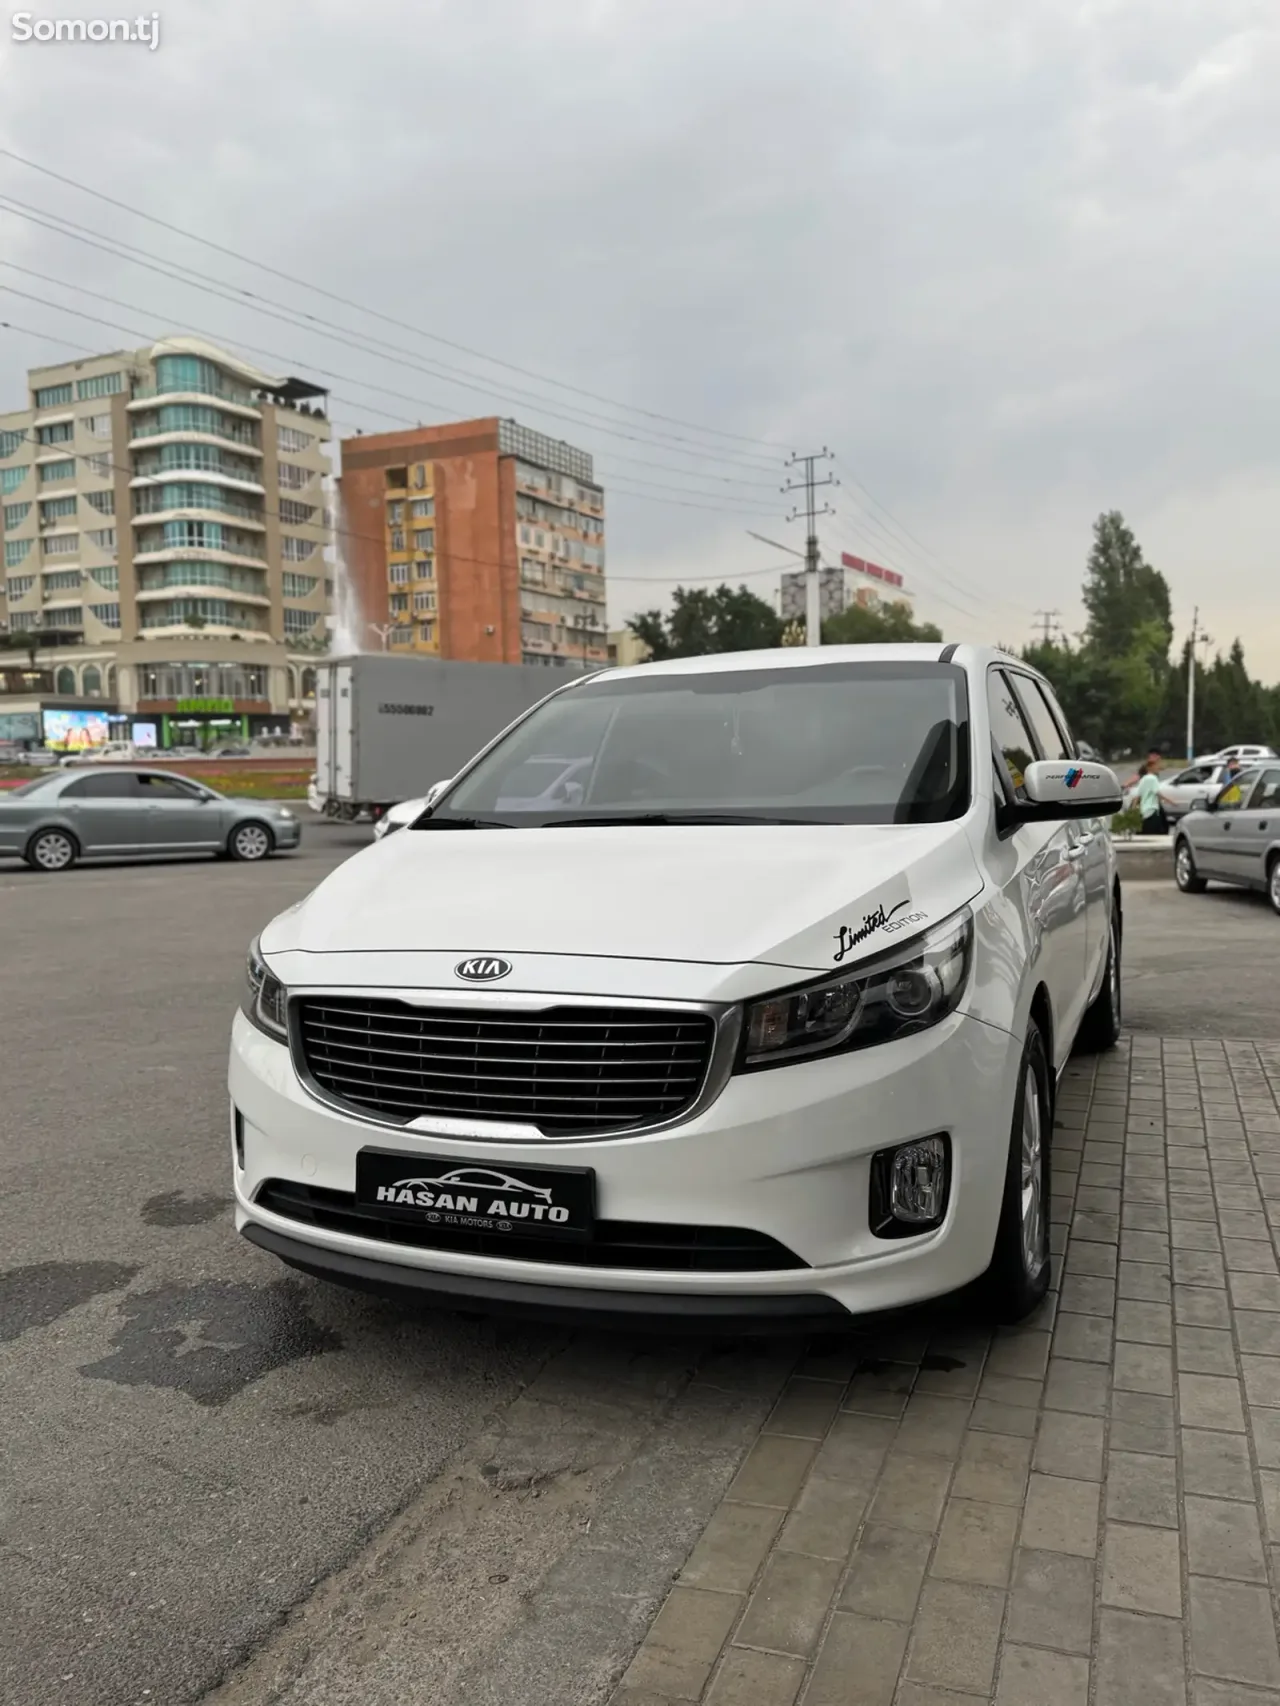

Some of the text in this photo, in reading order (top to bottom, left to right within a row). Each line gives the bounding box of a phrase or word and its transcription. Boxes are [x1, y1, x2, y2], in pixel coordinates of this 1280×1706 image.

[833, 899, 910, 962] Limited
[881, 911, 929, 934] EDITION
[462, 959, 501, 975] KIA
[376, 1185, 570, 1223] HASAN AUTO
[445, 1215, 459, 1224] KIA
[460, 1217, 494, 1229] MOTORS
